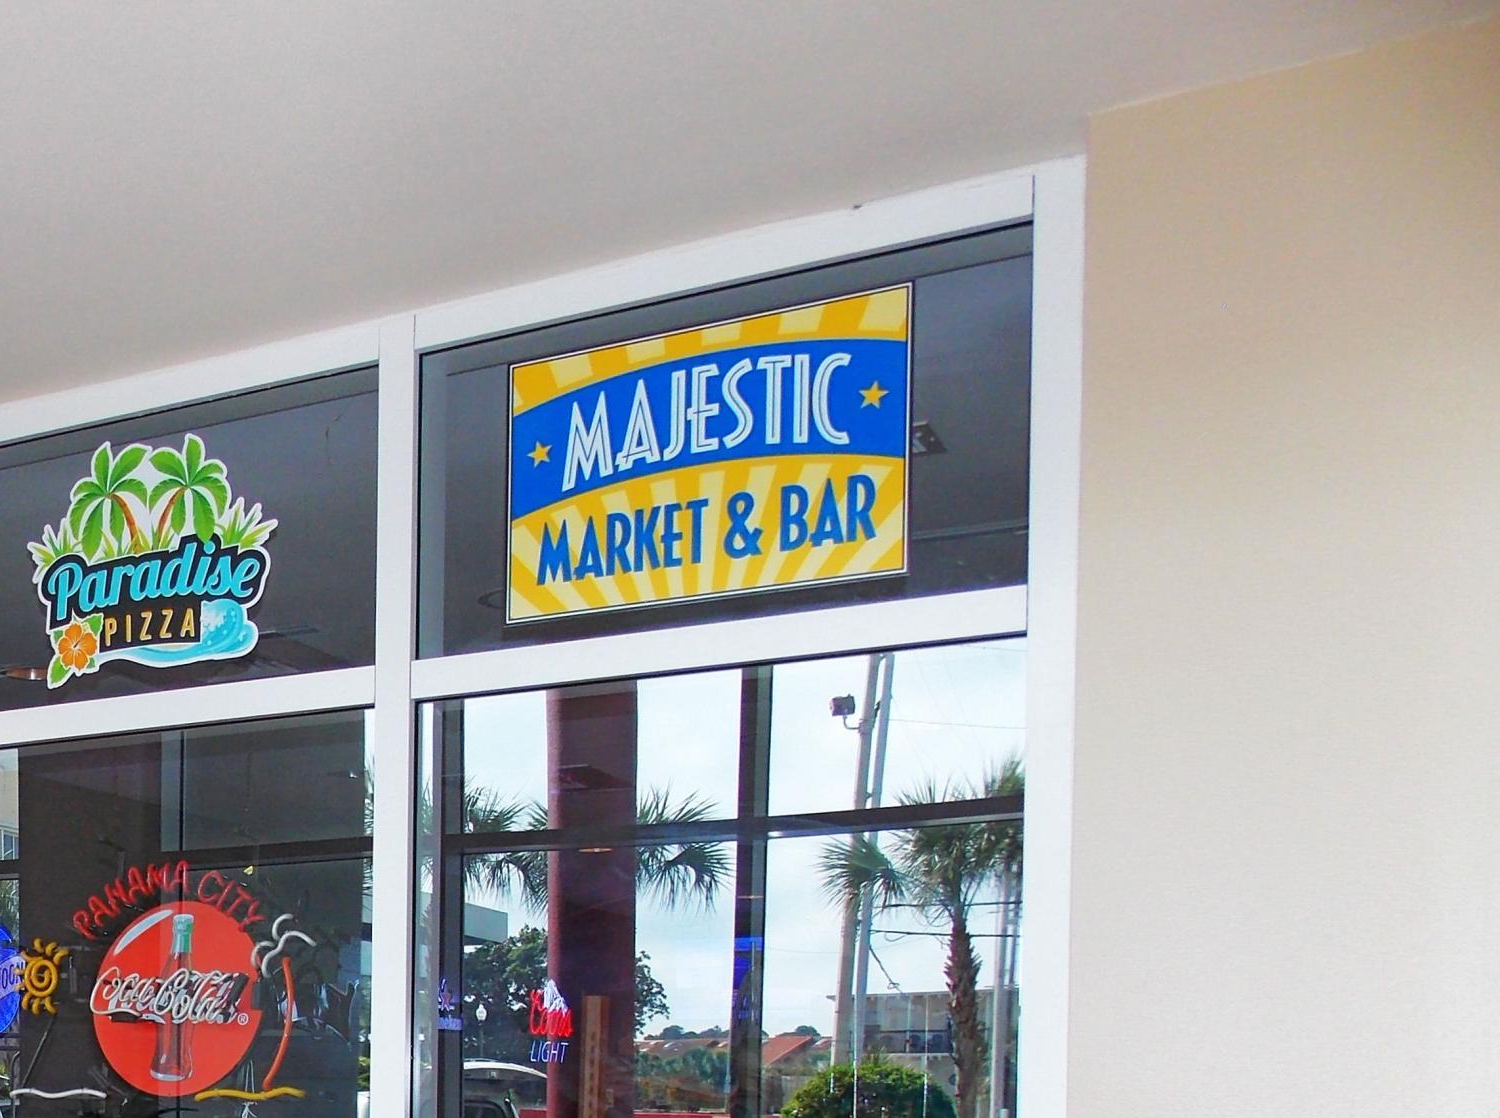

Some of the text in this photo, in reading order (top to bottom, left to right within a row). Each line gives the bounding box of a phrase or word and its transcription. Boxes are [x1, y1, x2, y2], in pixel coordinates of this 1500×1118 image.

[561, 351, 851, 492] MAJESTIC
[536, 473, 877, 586] MARKET & BAR
[47, 541, 261, 621] Paradise
[103, 607, 196, 647] PIZZA
[73, 859, 268, 941] PANAMA CITY
[530, 1040, 570, 1063] LIGHT
